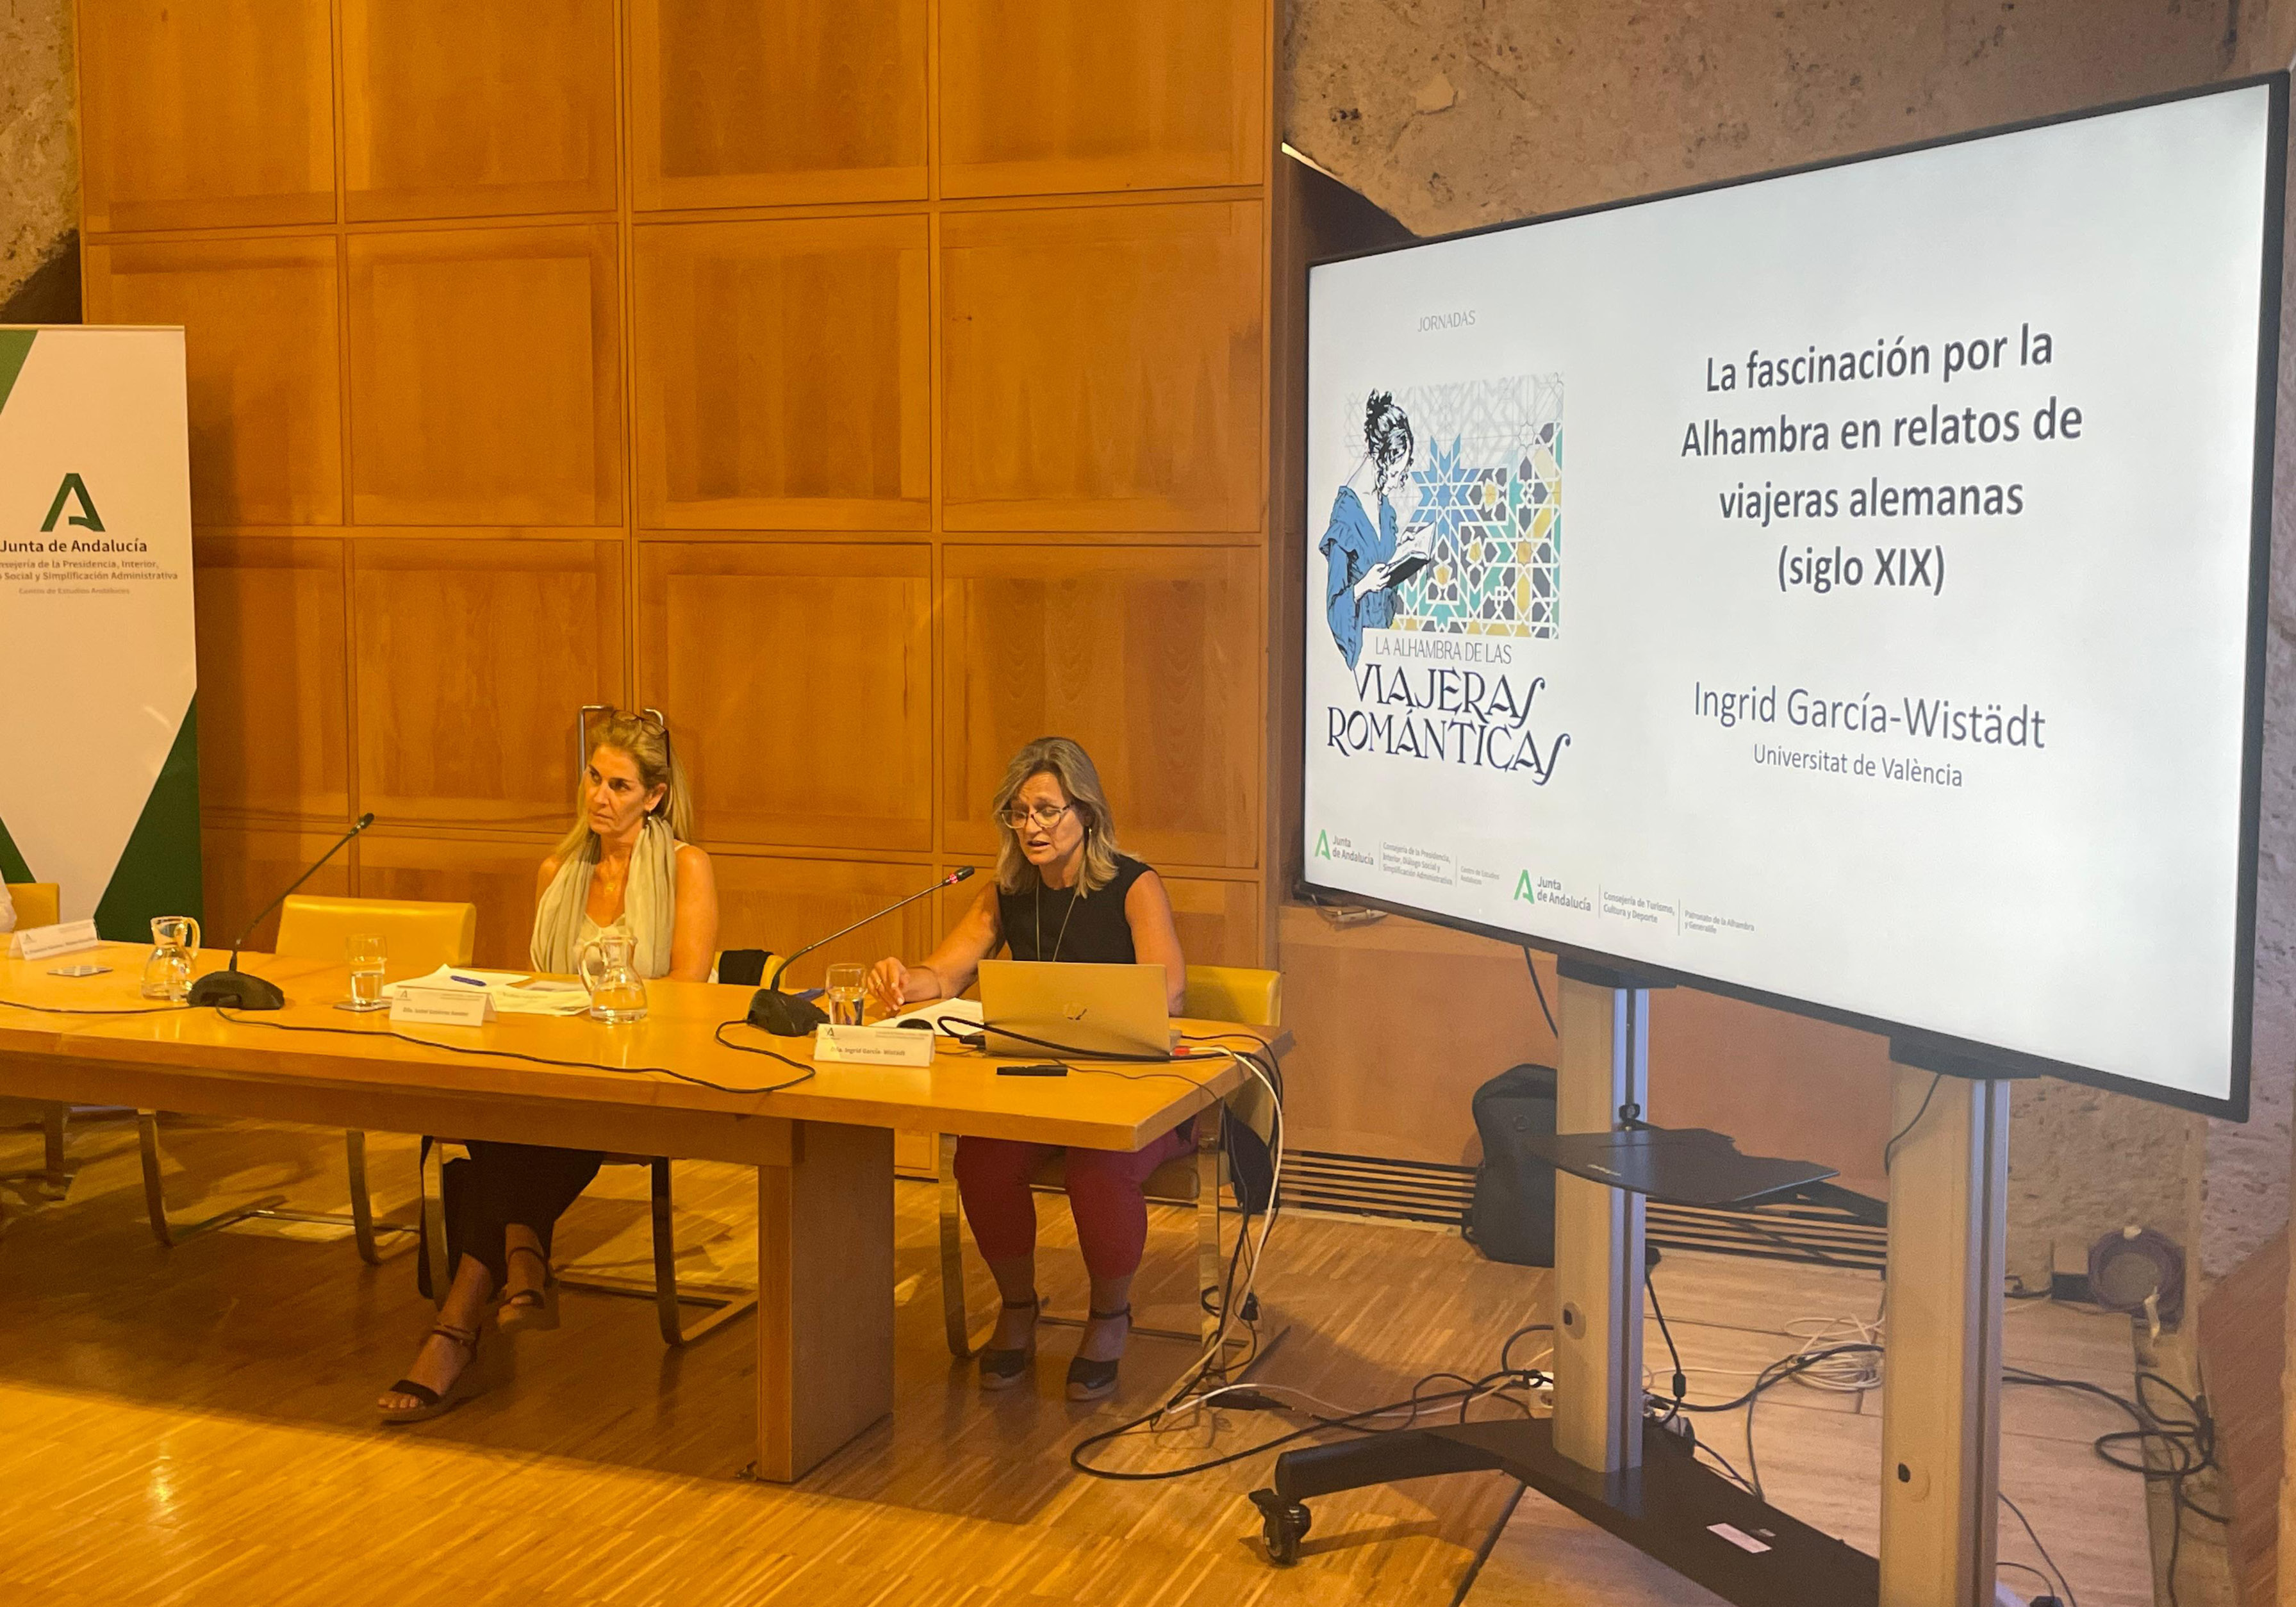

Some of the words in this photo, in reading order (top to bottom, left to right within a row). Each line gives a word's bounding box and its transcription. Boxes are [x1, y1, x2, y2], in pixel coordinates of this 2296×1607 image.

[1417, 309, 1476, 333] JORNADAS
[1706, 357, 1736, 392] La
[1746, 335, 1929, 389] fascinación
[1943, 336, 2008, 383] por
[2020, 322, 2052, 366] la
[1681, 414, 1829, 457] Alhambra
[1840, 419, 1881, 450] en
[1894, 404, 2020, 447] relatos
[2033, 395, 2083, 441] de
[1719, 481, 1838, 528] viajeras
[1849, 476, 2023, 518] alemanas
[0, 540, 44, 552] Junta
[49, 539, 67, 552] de
[71, 538, 147, 552] Andalucía
[4, 572, 33, 580] Social
[43, 571, 108, 581] Simplificación
[111, 572, 178, 580] Administrativa
[1778, 545, 1863, 594] (siglo
[1874, 545, 1945, 597] XIX)
[1375, 636, 1391, 655] LA
[1393, 638, 1462, 661] ALHAMBRA
[1465, 641, 1483, 663] DE
[1485, 643, 1512, 664] LAS
[1353, 663, 1546, 729] VIAJERAS
[1695, 681, 1776, 728] Ingrid
[1787, 688, 2046, 748] García-Wistädt
[1327, 706, 1571, 786] ROMÁNTICAS
[1754, 743, 1848, 773] Universitat
[1853, 753, 1876, 777] de
[1881, 757, 1962, 787] València
[1333, 835, 1351, 847] Junta
[1332, 847, 1341, 858] de
[1341, 849, 1374, 865] Andalucía
[1537, 876, 1561, 890] Junta
[1537, 889, 1548, 902] de
[1548, 891, 1591, 911] Andalucía
[1637, 898, 1646, 908] de
[1646, 900, 1676, 916] Turismo,
[1603, 904, 1626, 916] Cultura
[1626, 910, 1631, 919] y
[1631, 910, 1658, 923] Deporte
